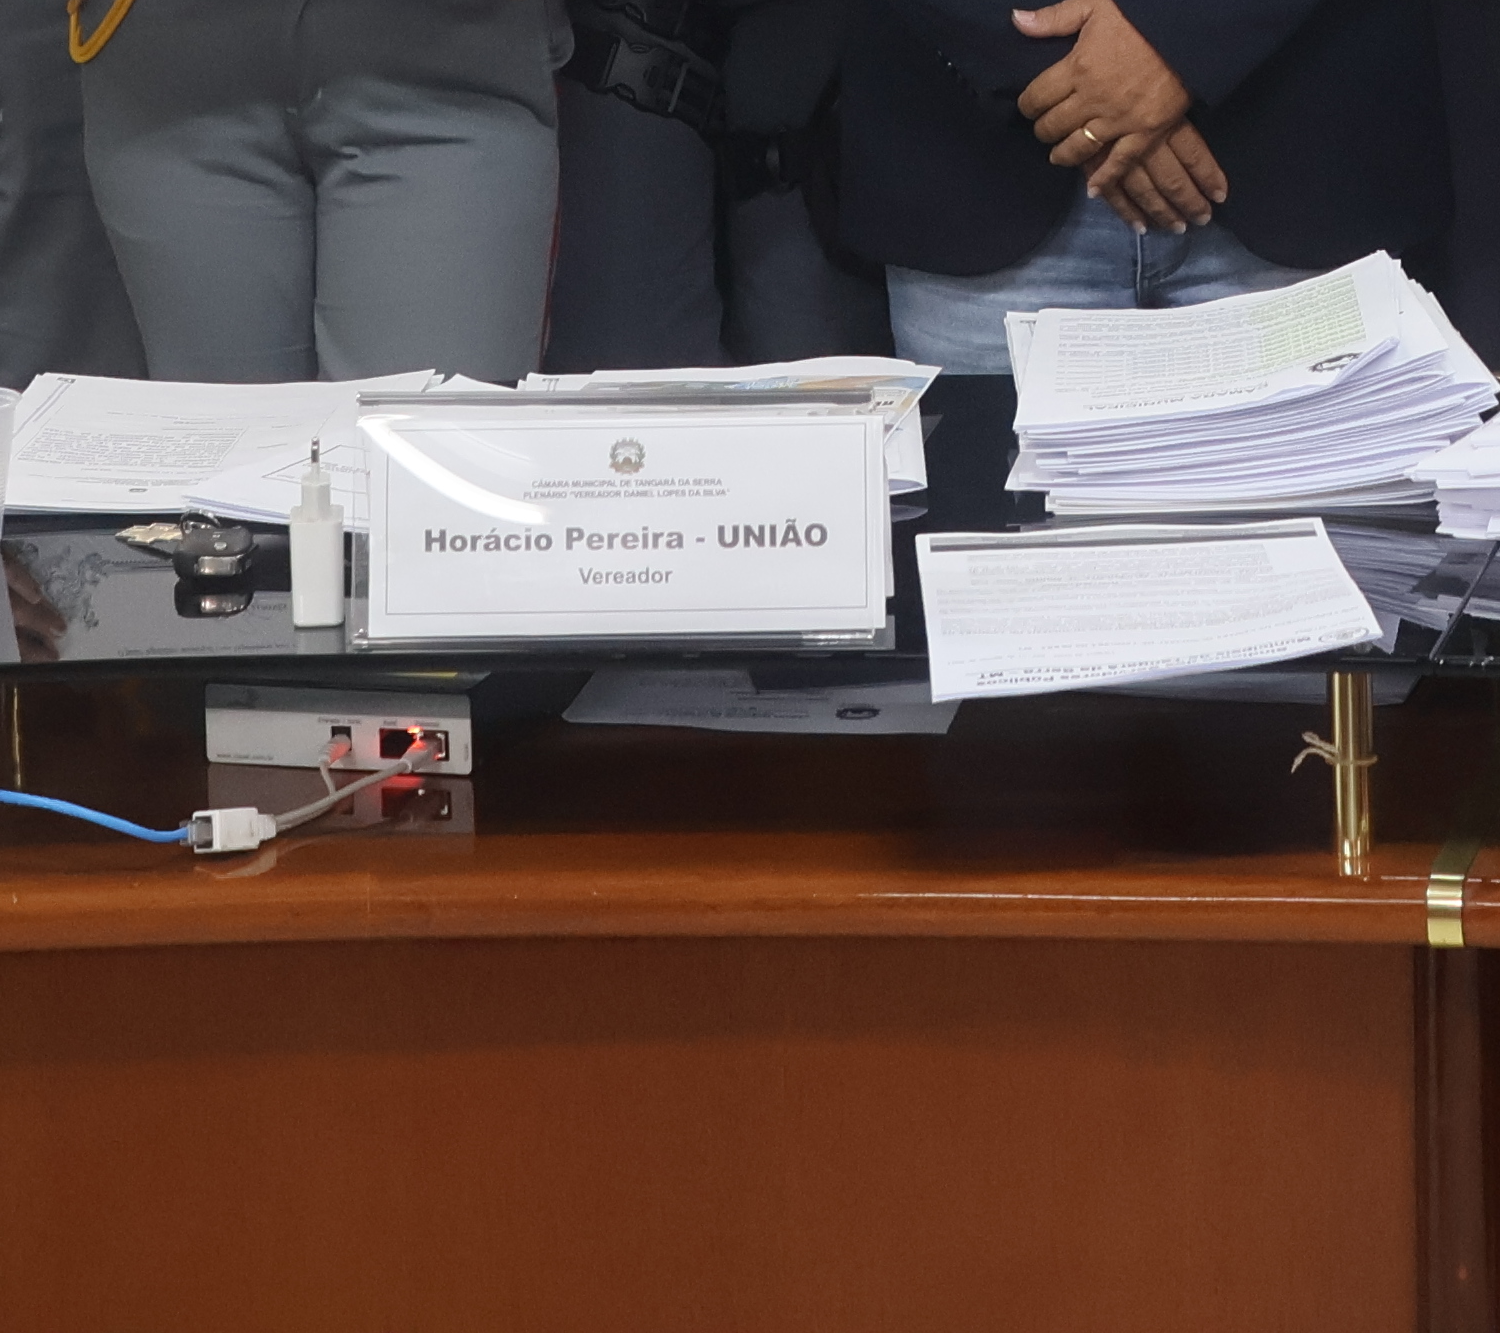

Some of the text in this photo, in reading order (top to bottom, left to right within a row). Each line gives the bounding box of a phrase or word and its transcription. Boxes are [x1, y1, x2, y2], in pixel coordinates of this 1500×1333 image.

[423, 527, 553, 554] Horácio
[564, 525, 685, 552] Pereira
[716, 518, 828, 549] UNIÃO
[578, 566, 673, 586] Vereador
